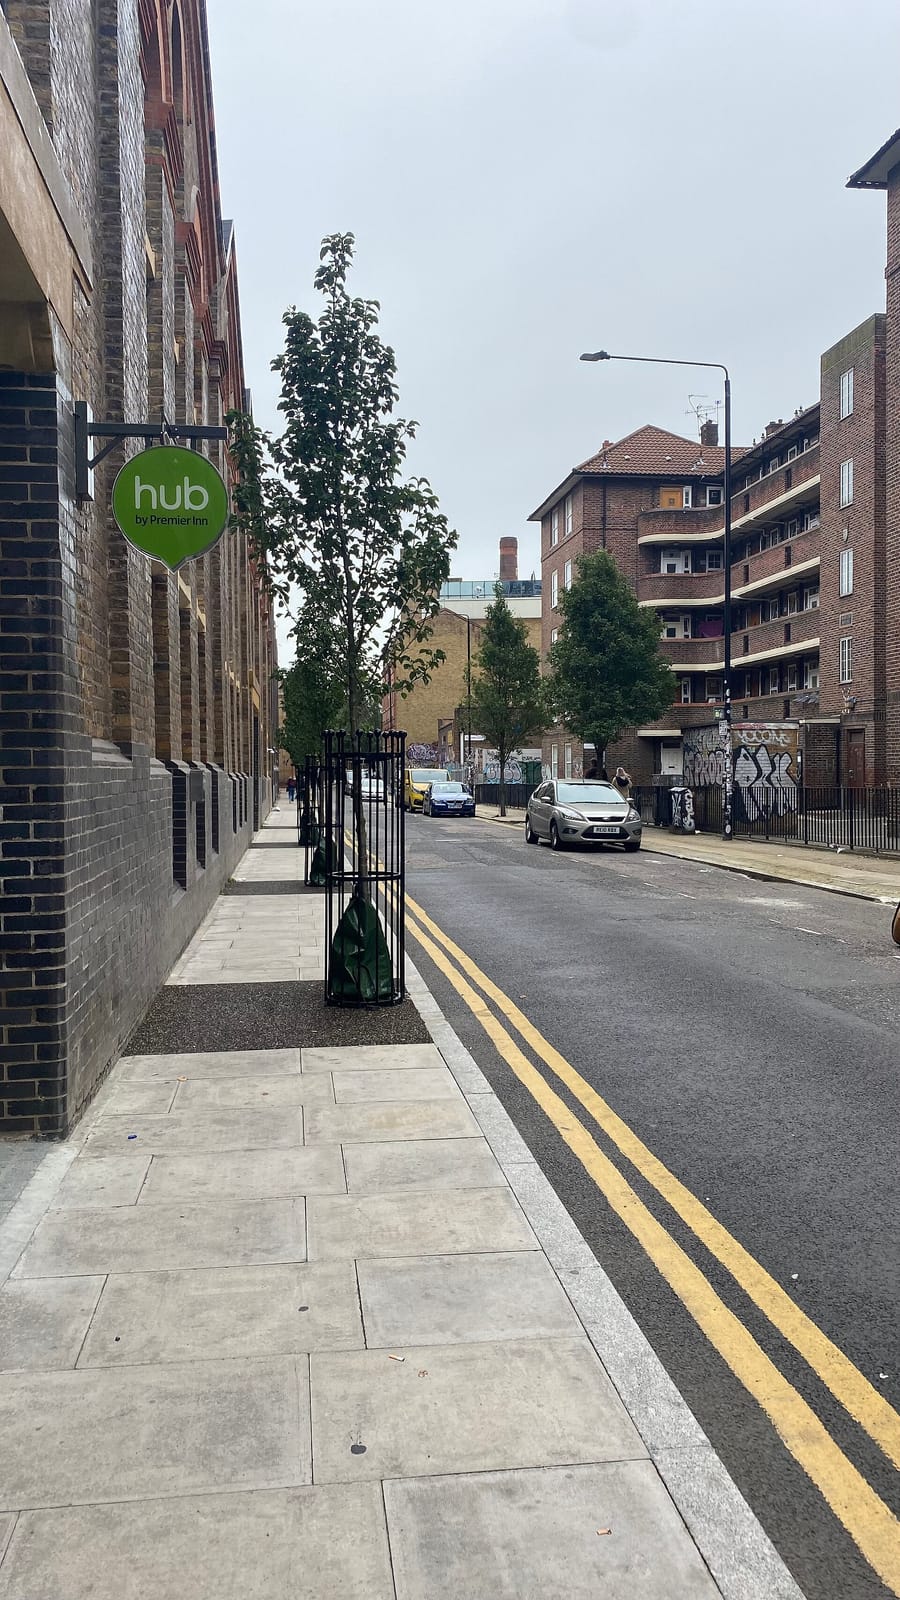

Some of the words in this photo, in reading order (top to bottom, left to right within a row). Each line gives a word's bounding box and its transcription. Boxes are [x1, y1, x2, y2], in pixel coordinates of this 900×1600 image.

[135, 475, 209, 511] hub
[135, 515, 148, 527] by
[150, 515, 190, 526] Premier
[192, 516, 209, 526] Inn
